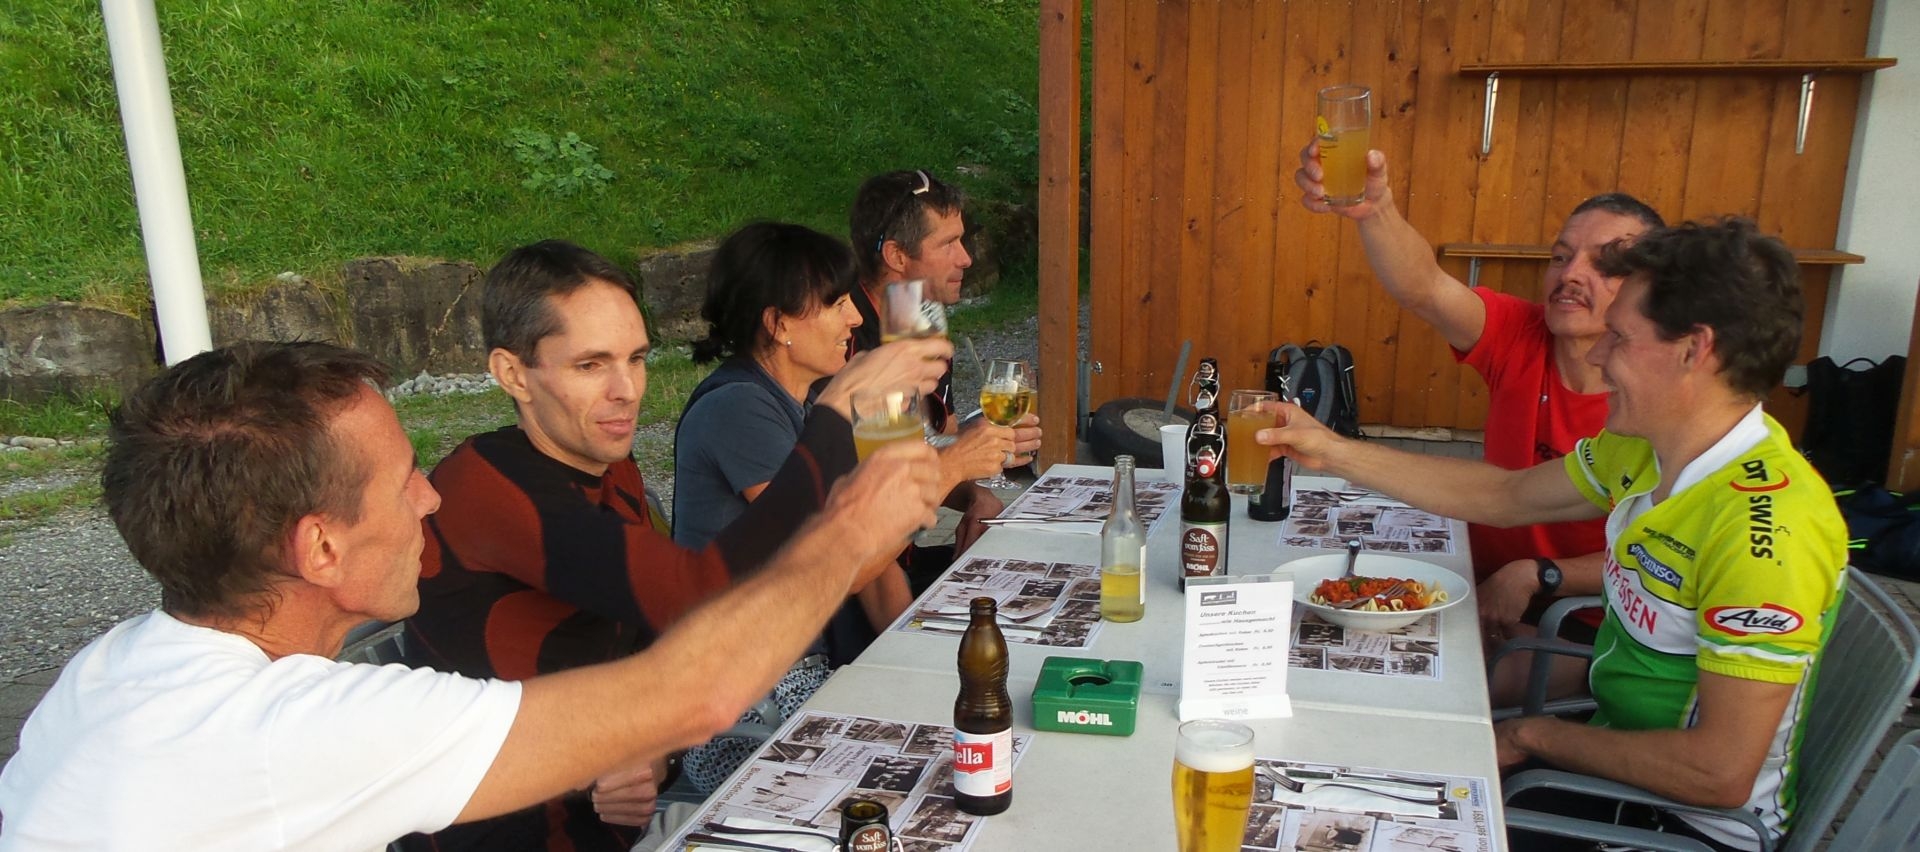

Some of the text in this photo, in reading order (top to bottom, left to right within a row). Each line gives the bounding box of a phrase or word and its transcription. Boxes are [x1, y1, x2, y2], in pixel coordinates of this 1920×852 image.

[1741, 459, 1773, 560] DT SWISS
[1189, 532, 1210, 544] Saft
[1717, 609, 1791, 632] Avid
[1057, 709, 1113, 726] MÖHL
[956, 747, 984, 765] ella
[862, 831, 882, 843] Saft
